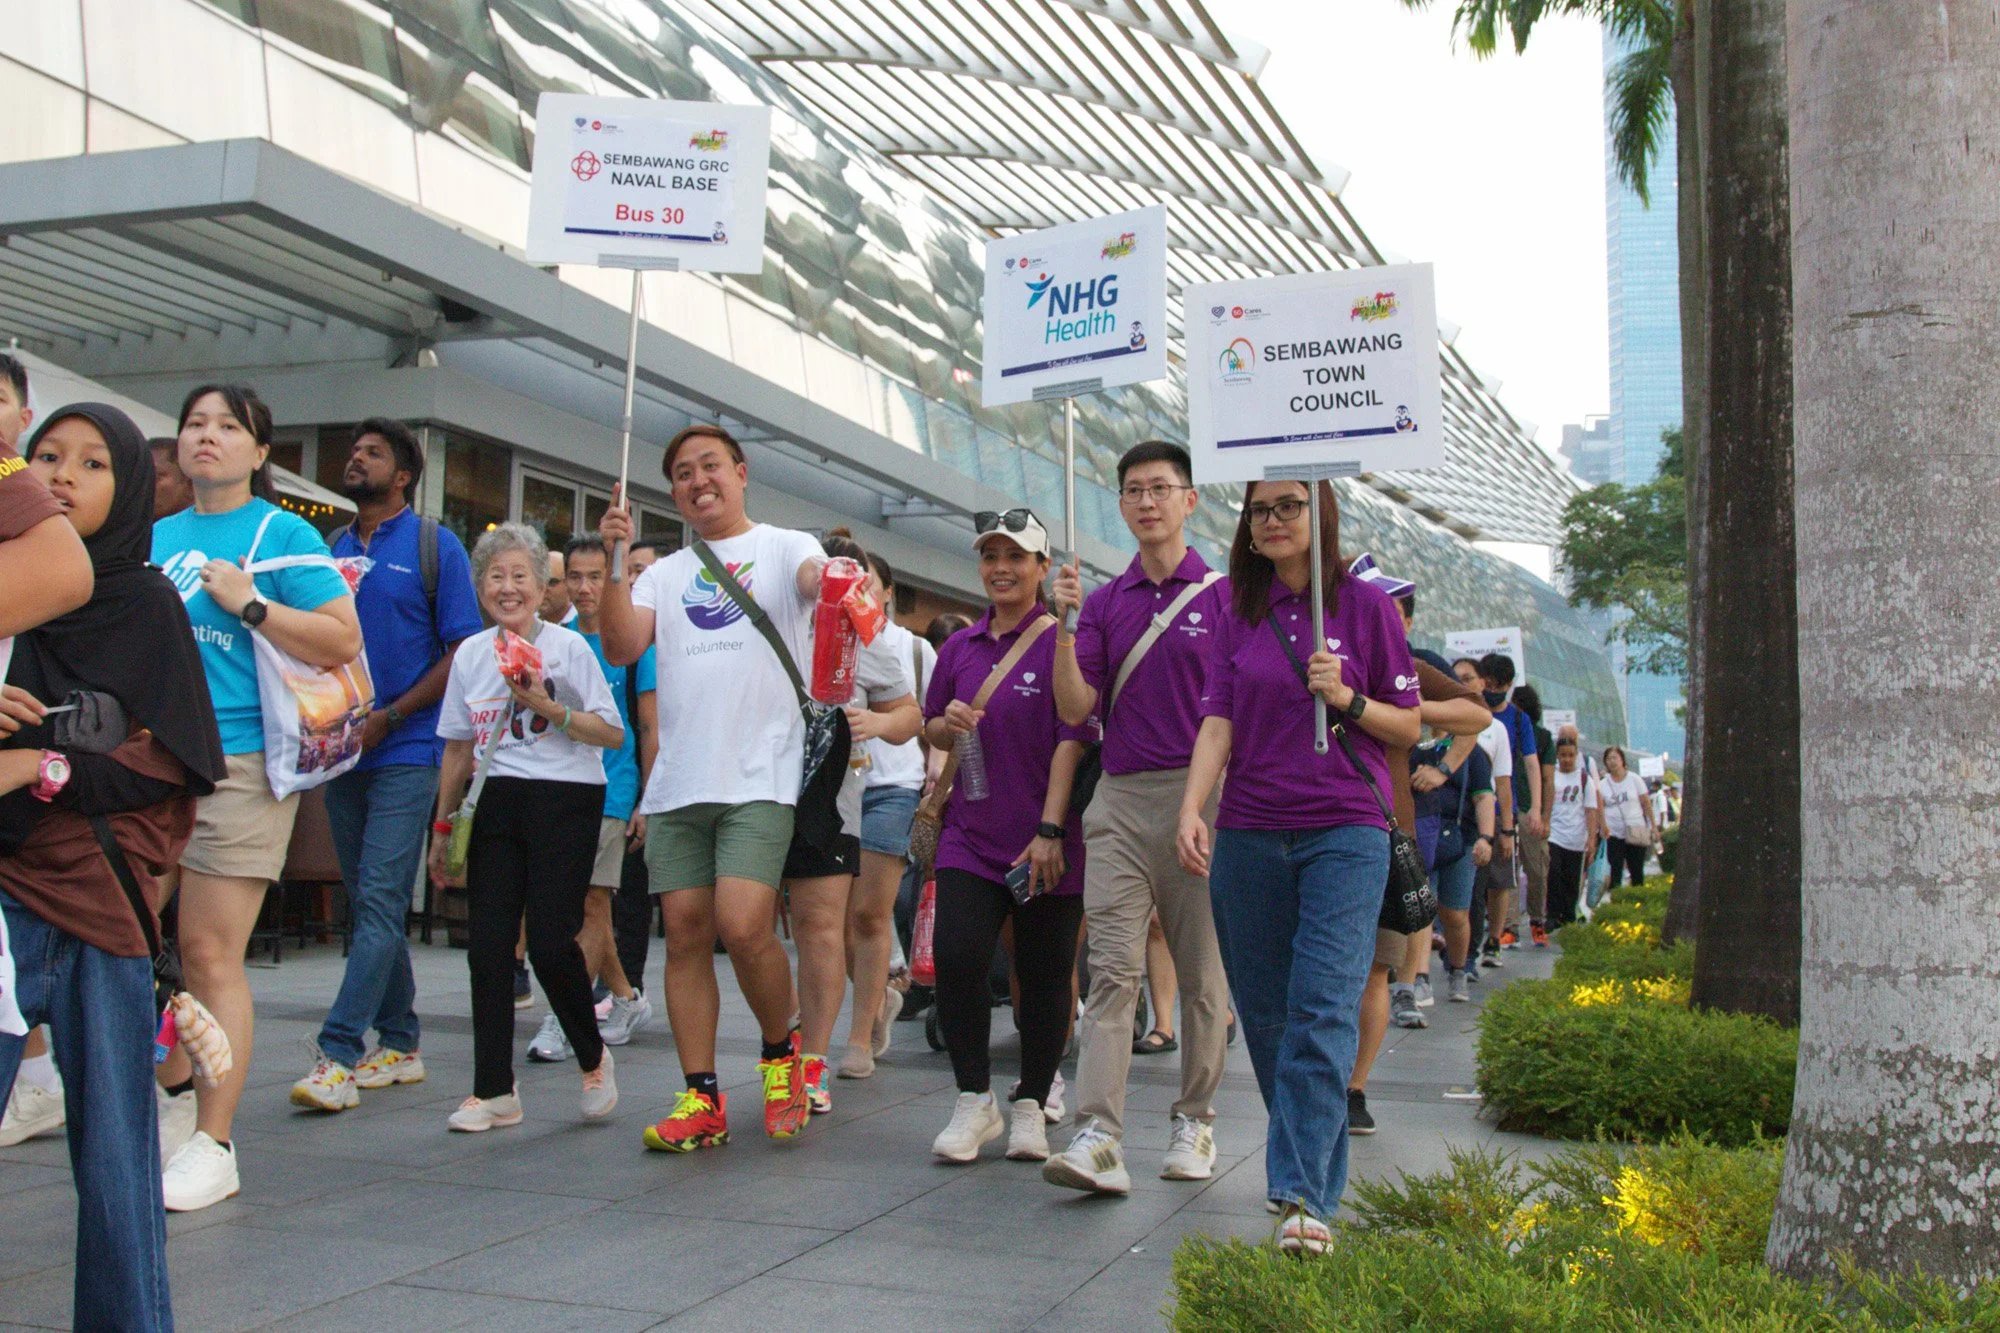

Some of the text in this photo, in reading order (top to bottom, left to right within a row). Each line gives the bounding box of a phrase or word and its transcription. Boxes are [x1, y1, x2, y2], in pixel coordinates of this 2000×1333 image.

[603, 153, 730, 173] SEMBAWANG GRC
[611, 172, 718, 191] NAVAL BASE
[615, 204, 684, 224] Bus 30
[1048, 274, 1119, 318] NHG
[1045, 309, 1116, 344] Health
[1263, 333, 1403, 362] SEMBAWANG
[1303, 364, 1366, 386] TOWN
[1290, 390, 1383, 412] COUNCIL
[686, 640, 745, 656] Volunteer
[1466, 647, 1513, 655] SEMBAWANG
[1402, 891, 1418, 902] CR
